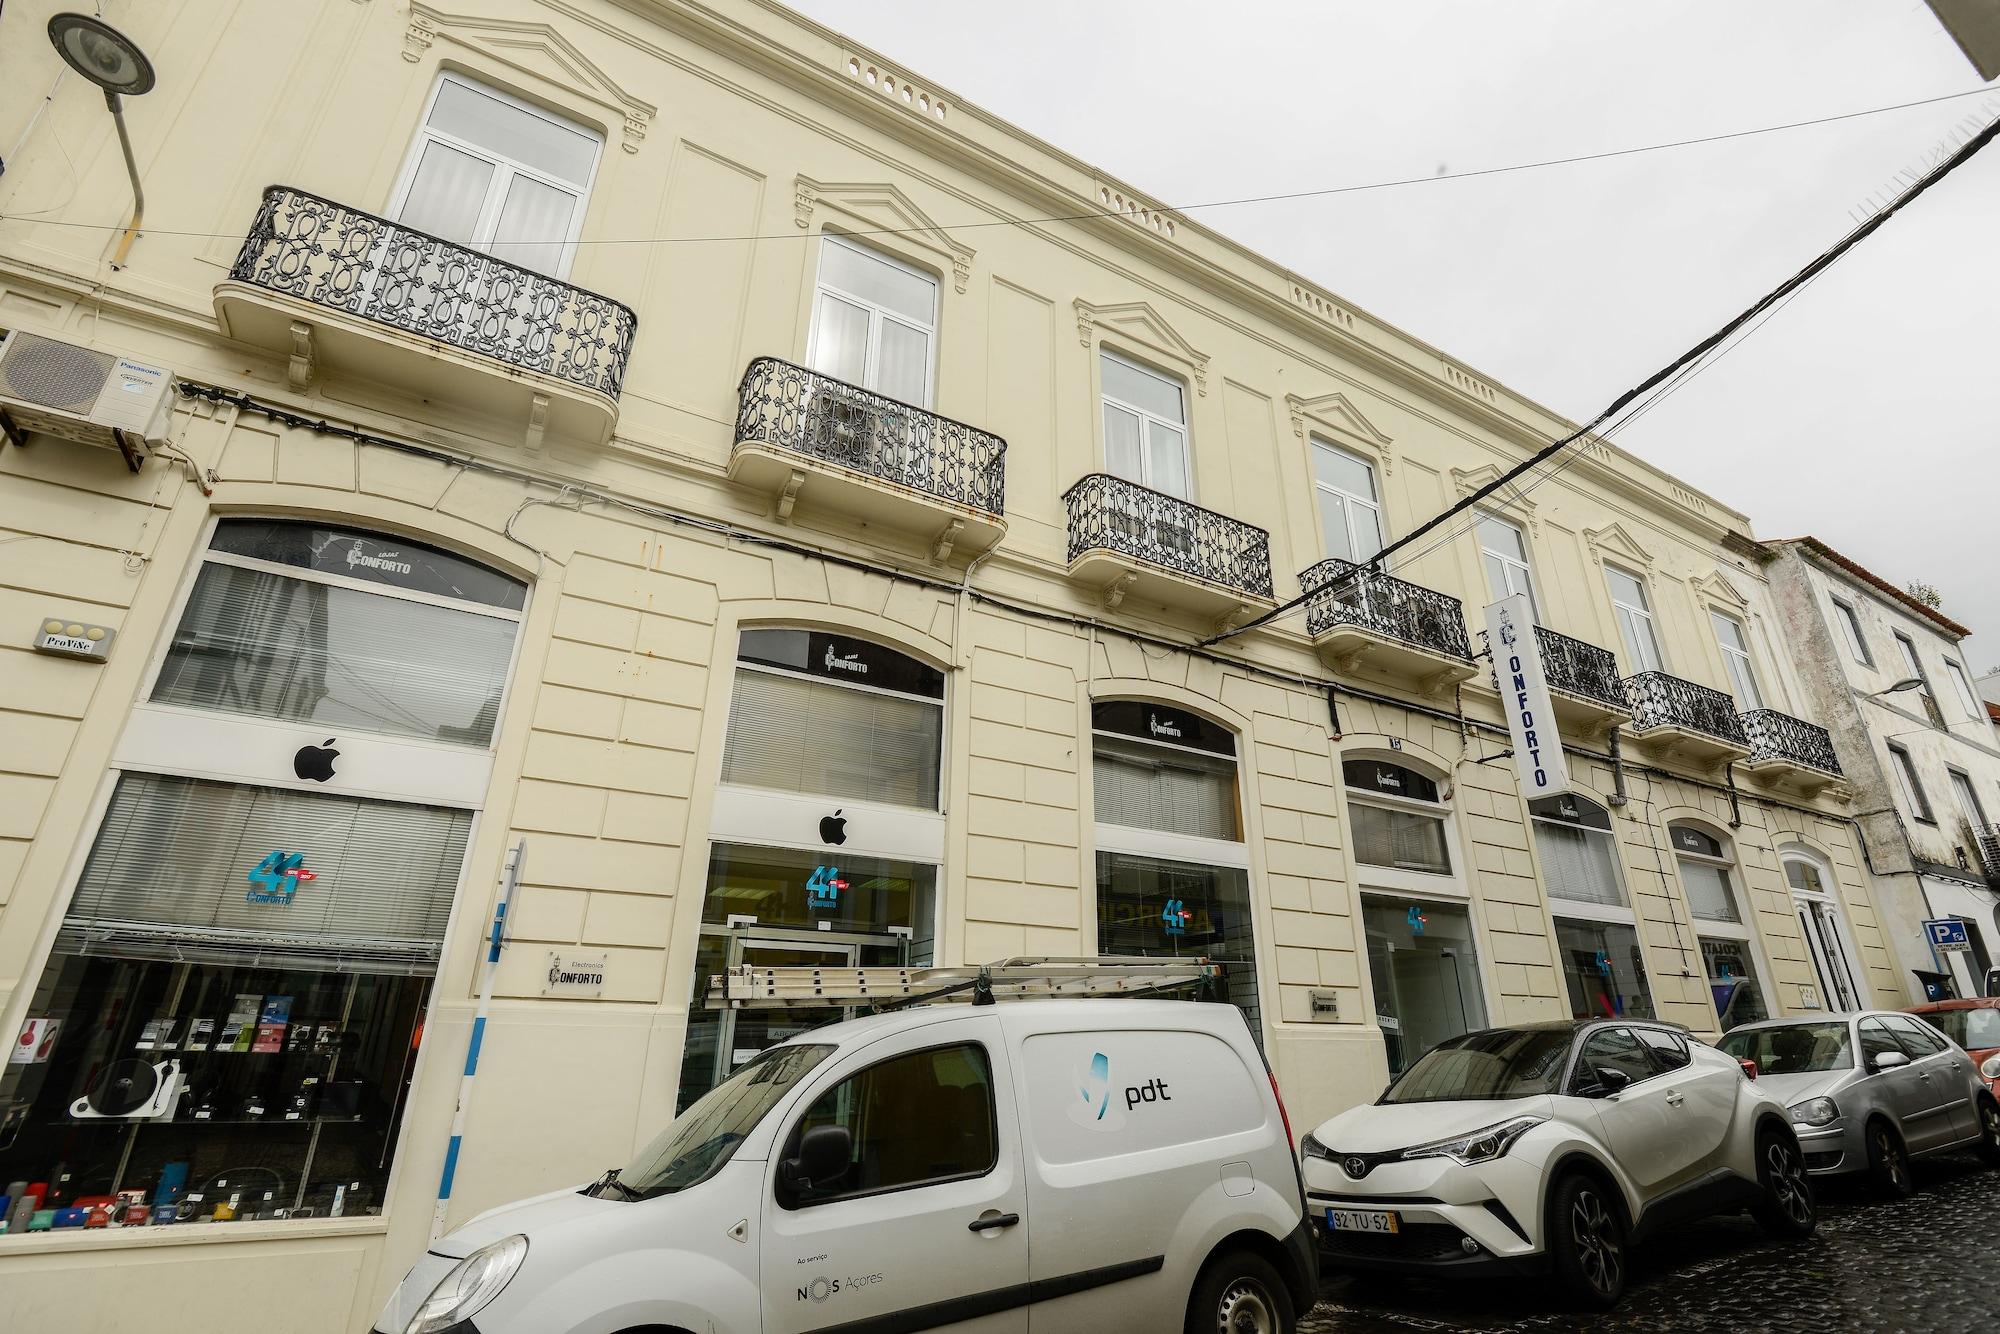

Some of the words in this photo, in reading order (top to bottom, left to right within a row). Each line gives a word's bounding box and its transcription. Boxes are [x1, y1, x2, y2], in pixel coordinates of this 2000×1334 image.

[120, 362, 162, 377] Panasonic
[1391, 738, 1401, 750] 15
[1934, 926, 1950, 942] P
[549, 967, 603, 985] CONFORTO
[1927, 985, 1935, 995] P
[1125, 1078, 1171, 1110] pdt
[806, 1253, 828, 1262] serviço
[797, 1275, 840, 1304] NOS
[844, 1272, 883, 1291] Açores
